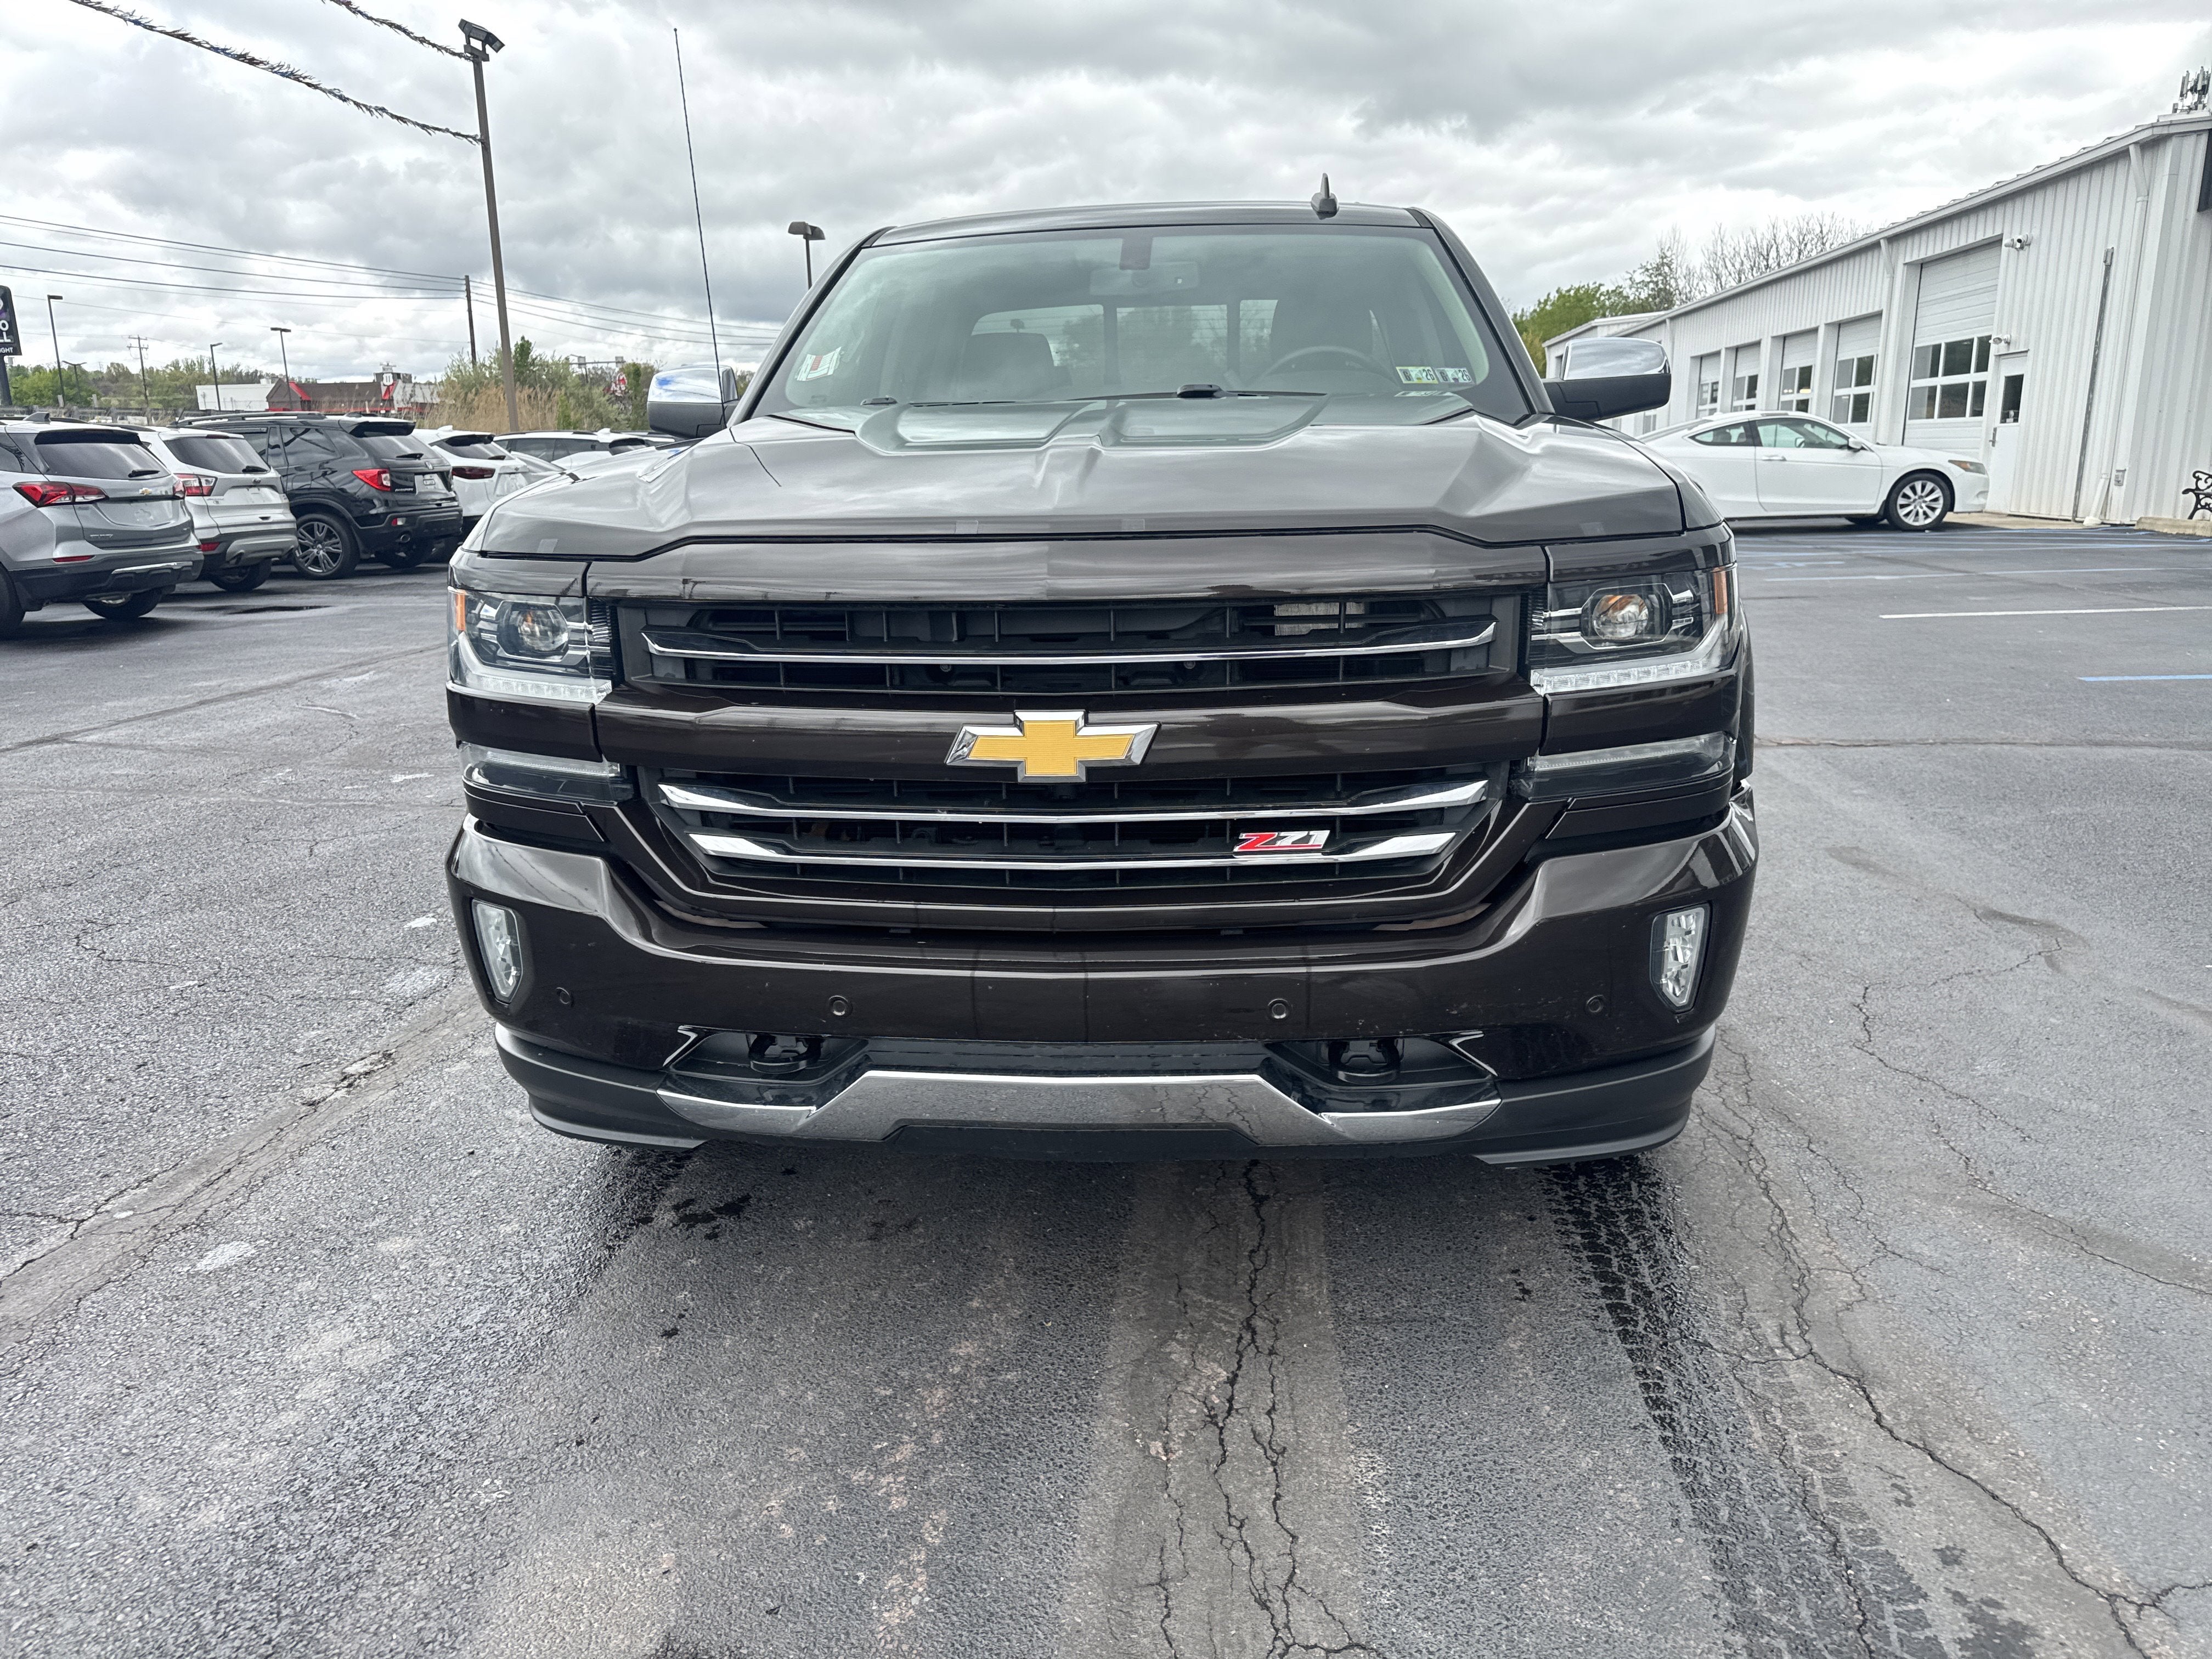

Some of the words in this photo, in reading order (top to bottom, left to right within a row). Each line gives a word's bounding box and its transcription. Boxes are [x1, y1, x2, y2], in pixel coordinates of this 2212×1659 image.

[1423, 369, 1435, 381] 26
[1440, 371, 1448, 382] 6
[1458, 369, 1471, 381] 26
[1233, 830, 1330, 851] Z71
